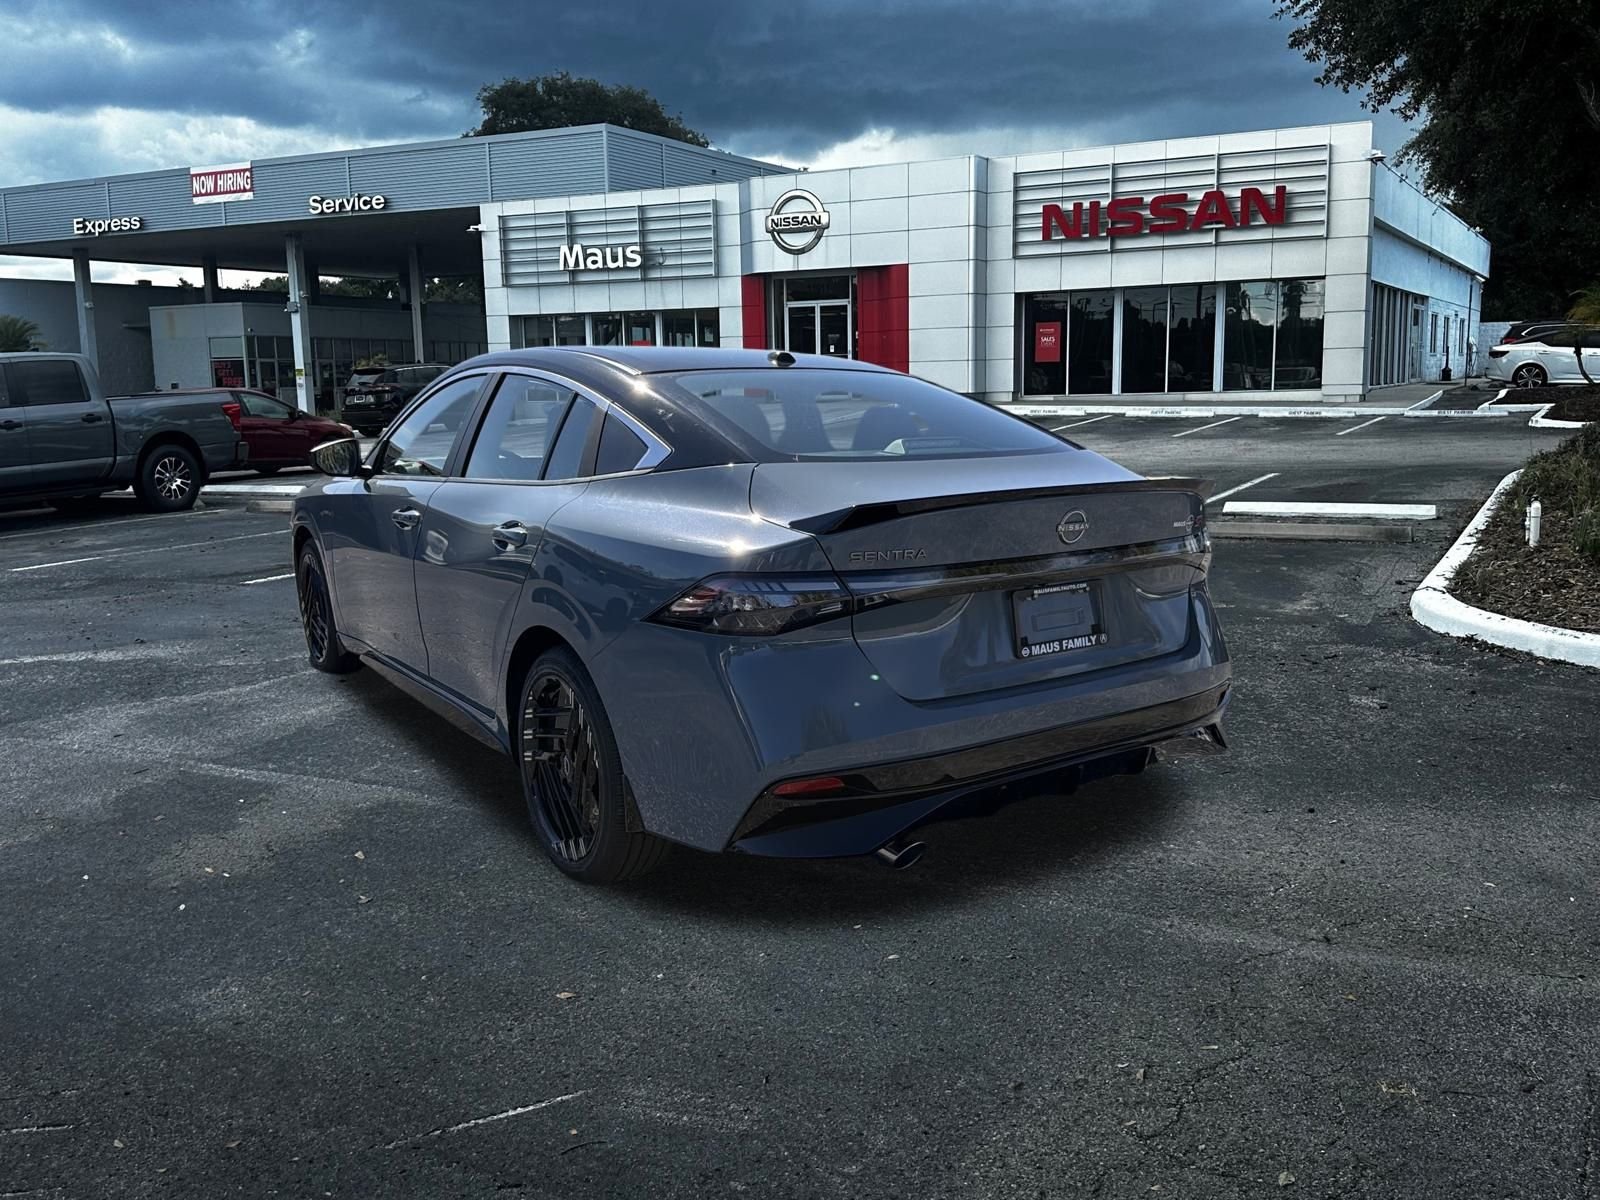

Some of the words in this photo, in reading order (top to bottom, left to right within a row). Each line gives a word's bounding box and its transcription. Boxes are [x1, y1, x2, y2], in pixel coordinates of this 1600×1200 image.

[192, 175, 215, 195] NOW
[217, 171, 251, 193] HIRING
[308, 193, 385, 215] Service
[1042, 185, 1287, 241] NISSAN
[73, 215, 141, 236] Express
[770, 214, 822, 230] NISSAN
[559, 243, 642, 271] Maus
[1057, 523, 1089, 531] NISSAN
[849, 548, 928, 562] SENTRA
[1033, 583, 1087, 594] MAUSFAMILYAUTO.COM
[1031, 641, 1060, 656] MAUS
[1062, 635, 1097, 651] FAMILY
